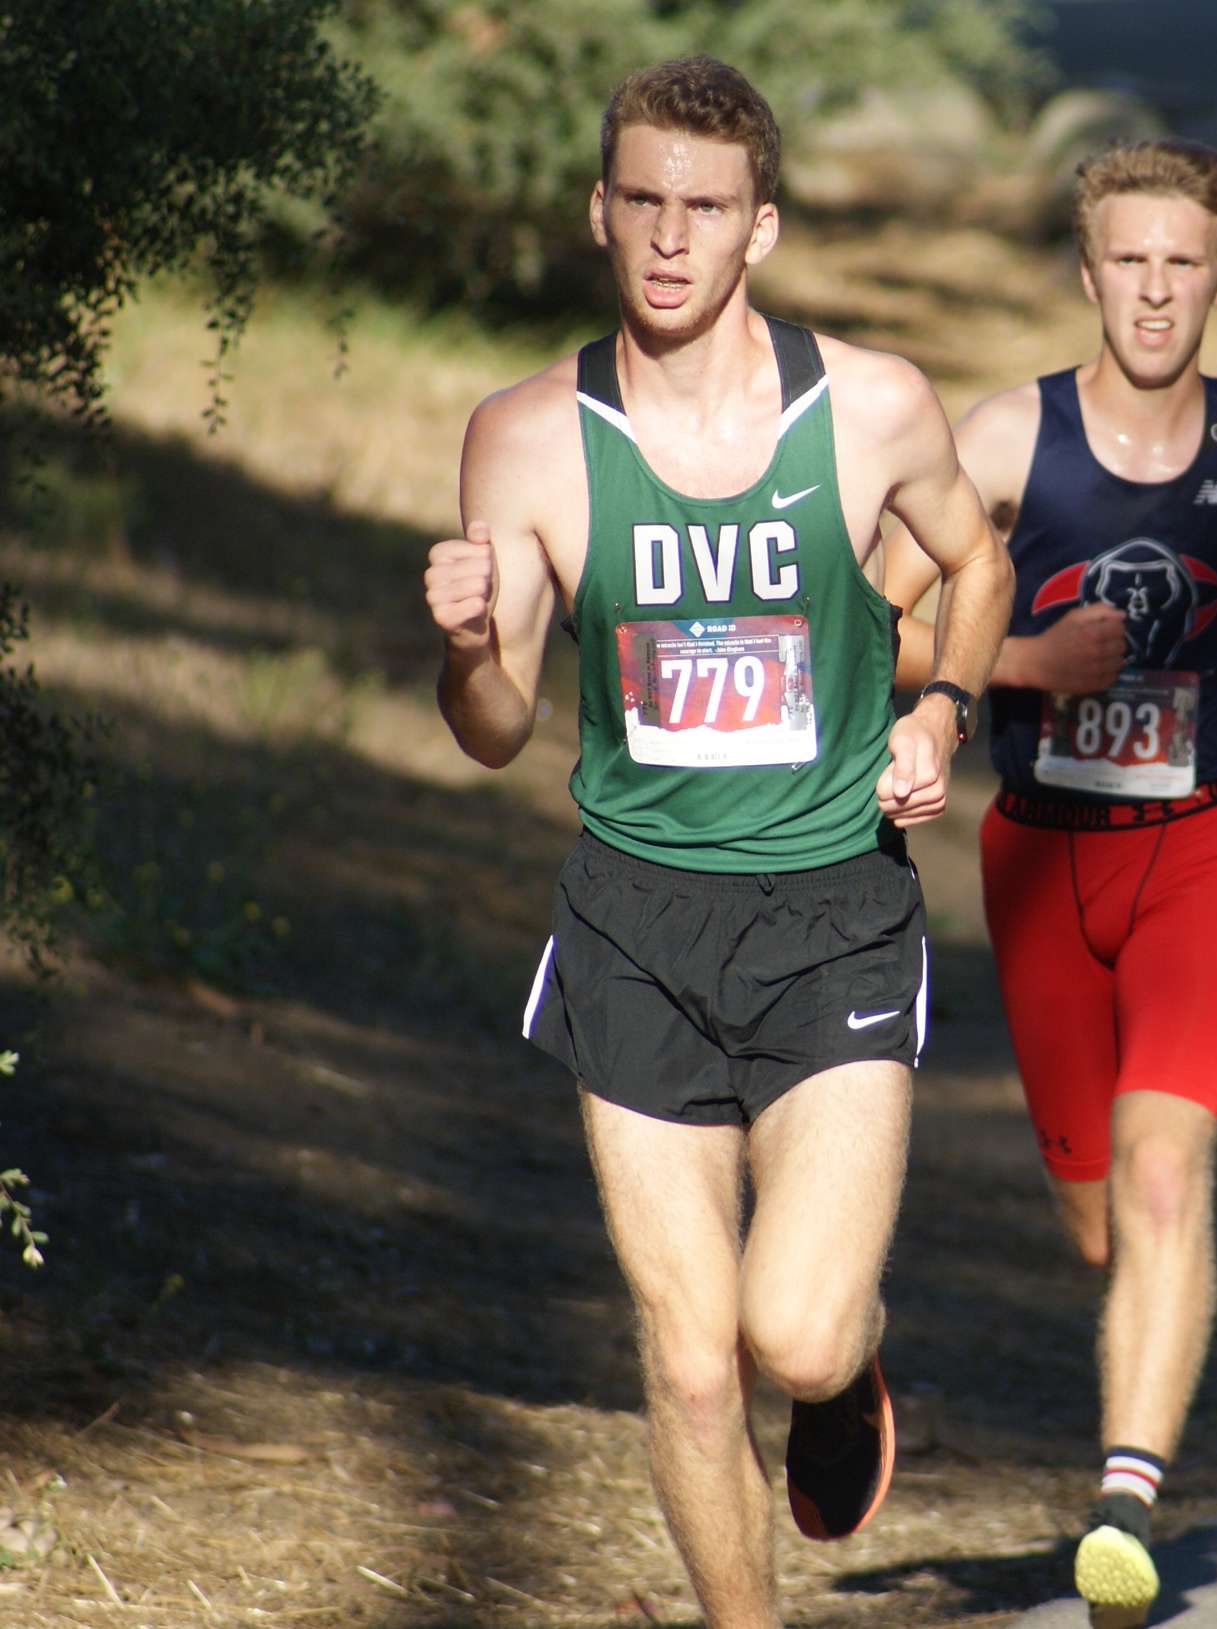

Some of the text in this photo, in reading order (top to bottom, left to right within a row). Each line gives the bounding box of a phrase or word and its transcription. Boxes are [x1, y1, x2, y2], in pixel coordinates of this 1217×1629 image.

[633, 519, 801, 606] DVC
[661, 656, 765, 723] 779
[1076, 698, 1160, 760] 893
